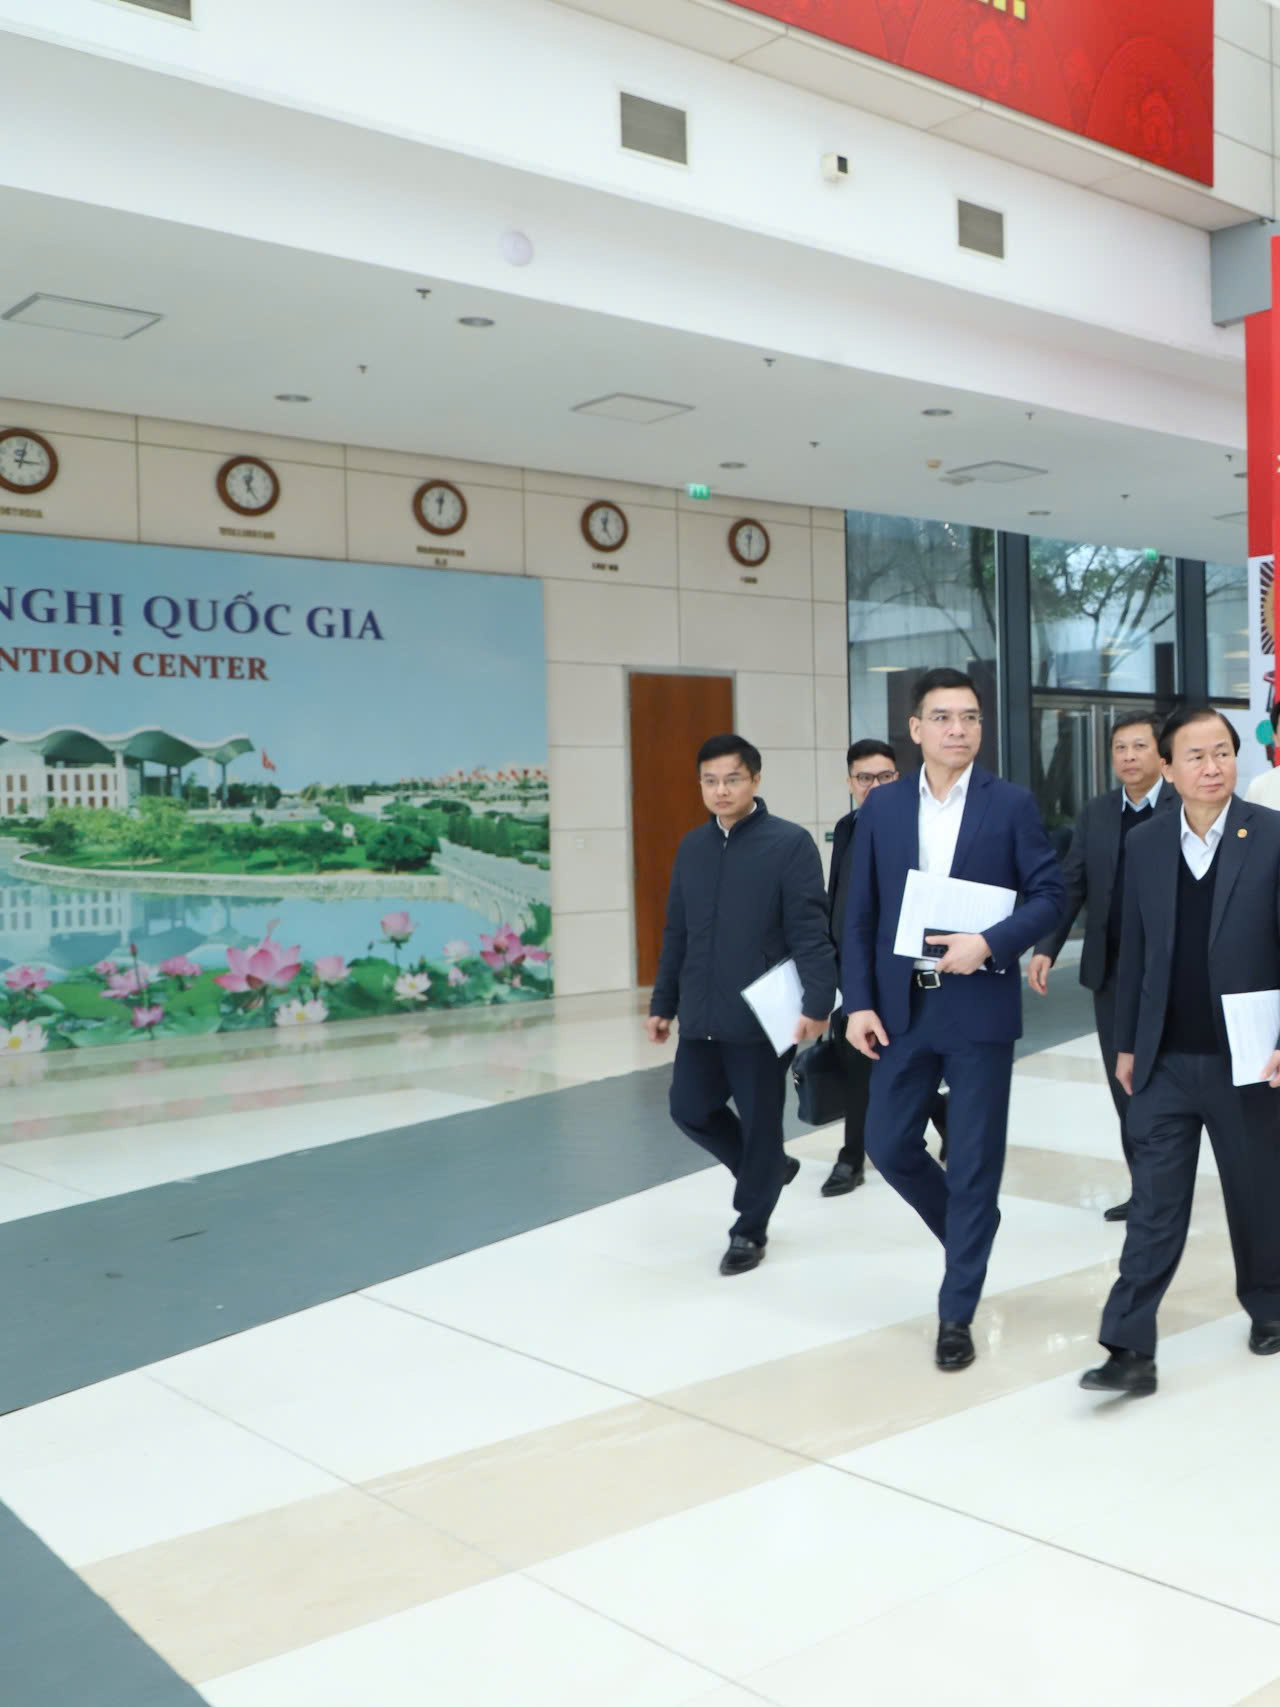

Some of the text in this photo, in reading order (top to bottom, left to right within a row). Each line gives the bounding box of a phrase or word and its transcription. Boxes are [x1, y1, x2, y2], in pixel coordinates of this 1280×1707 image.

[143, 591, 292, 639] QUỐC
[306, 605, 385, 641] GIA
[132, 652, 269, 681] CENTER
